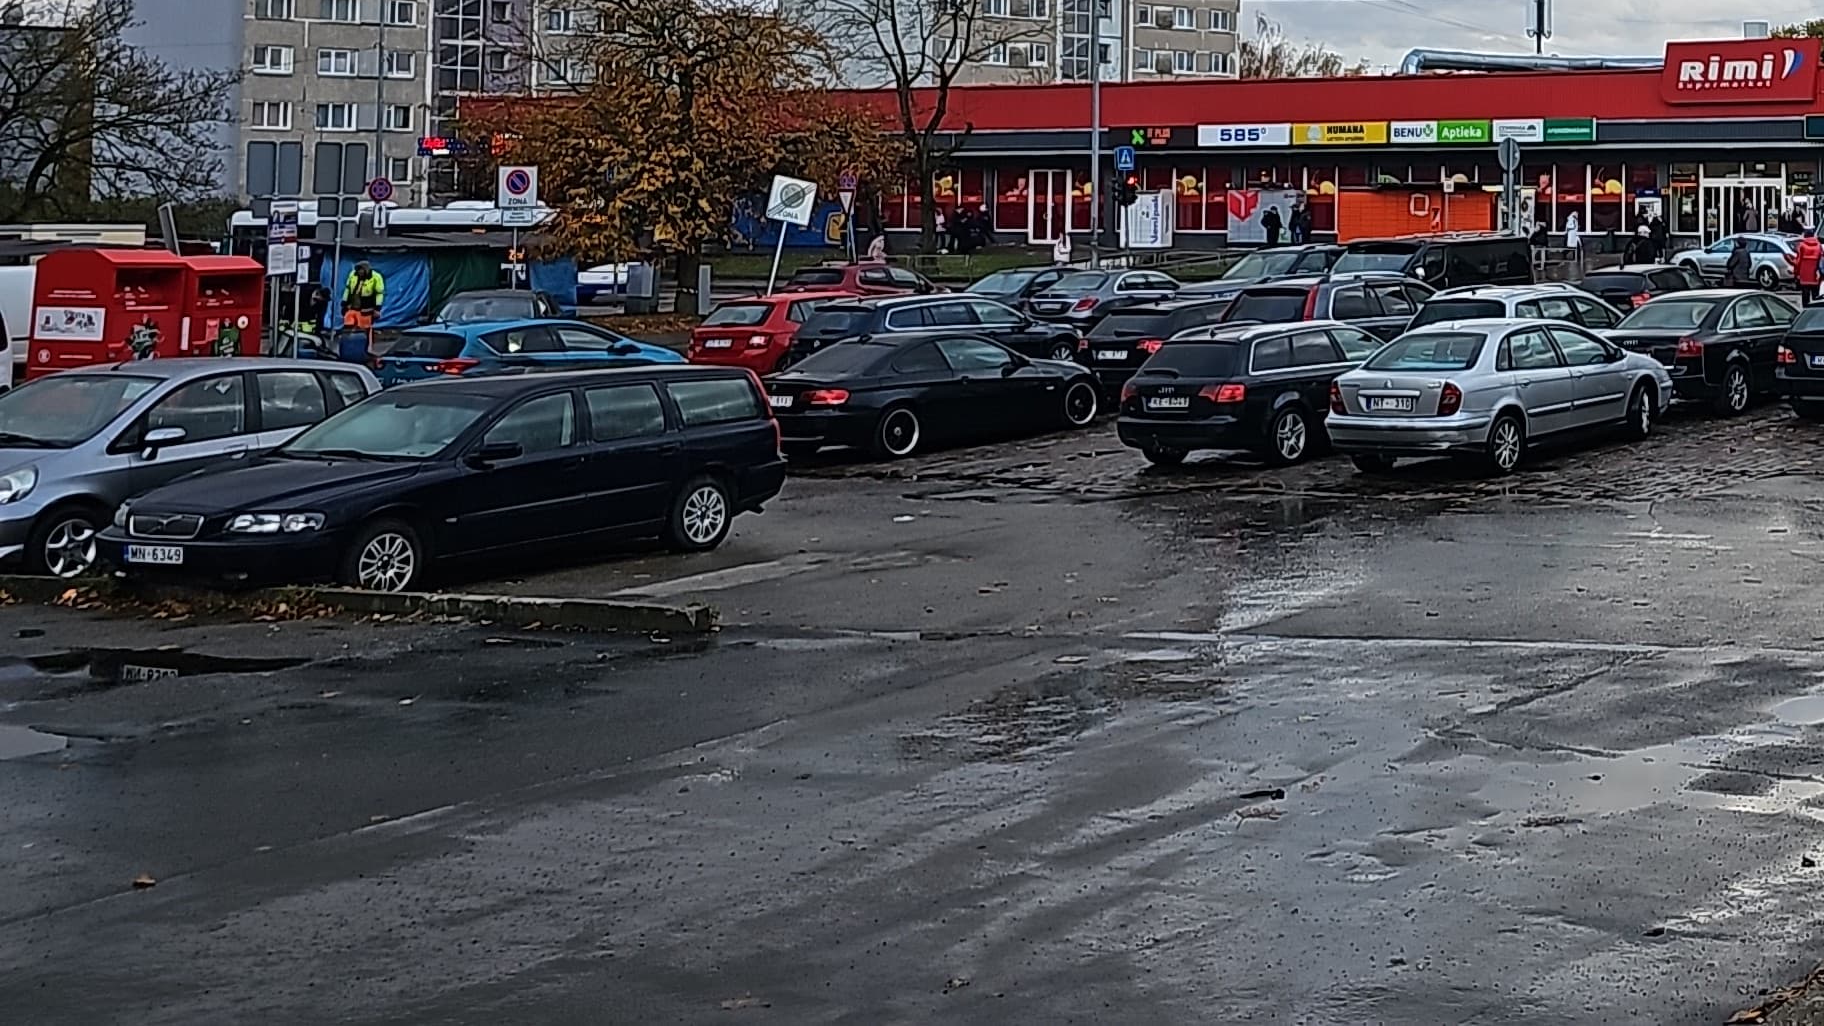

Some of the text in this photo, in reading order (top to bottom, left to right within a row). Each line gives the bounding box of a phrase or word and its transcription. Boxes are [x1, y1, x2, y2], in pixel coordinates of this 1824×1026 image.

[1679, 54, 1775, 81] Rimi
[1393, 126, 1422, 138] BENU
[1441, 125, 1482, 139] Aptieka
